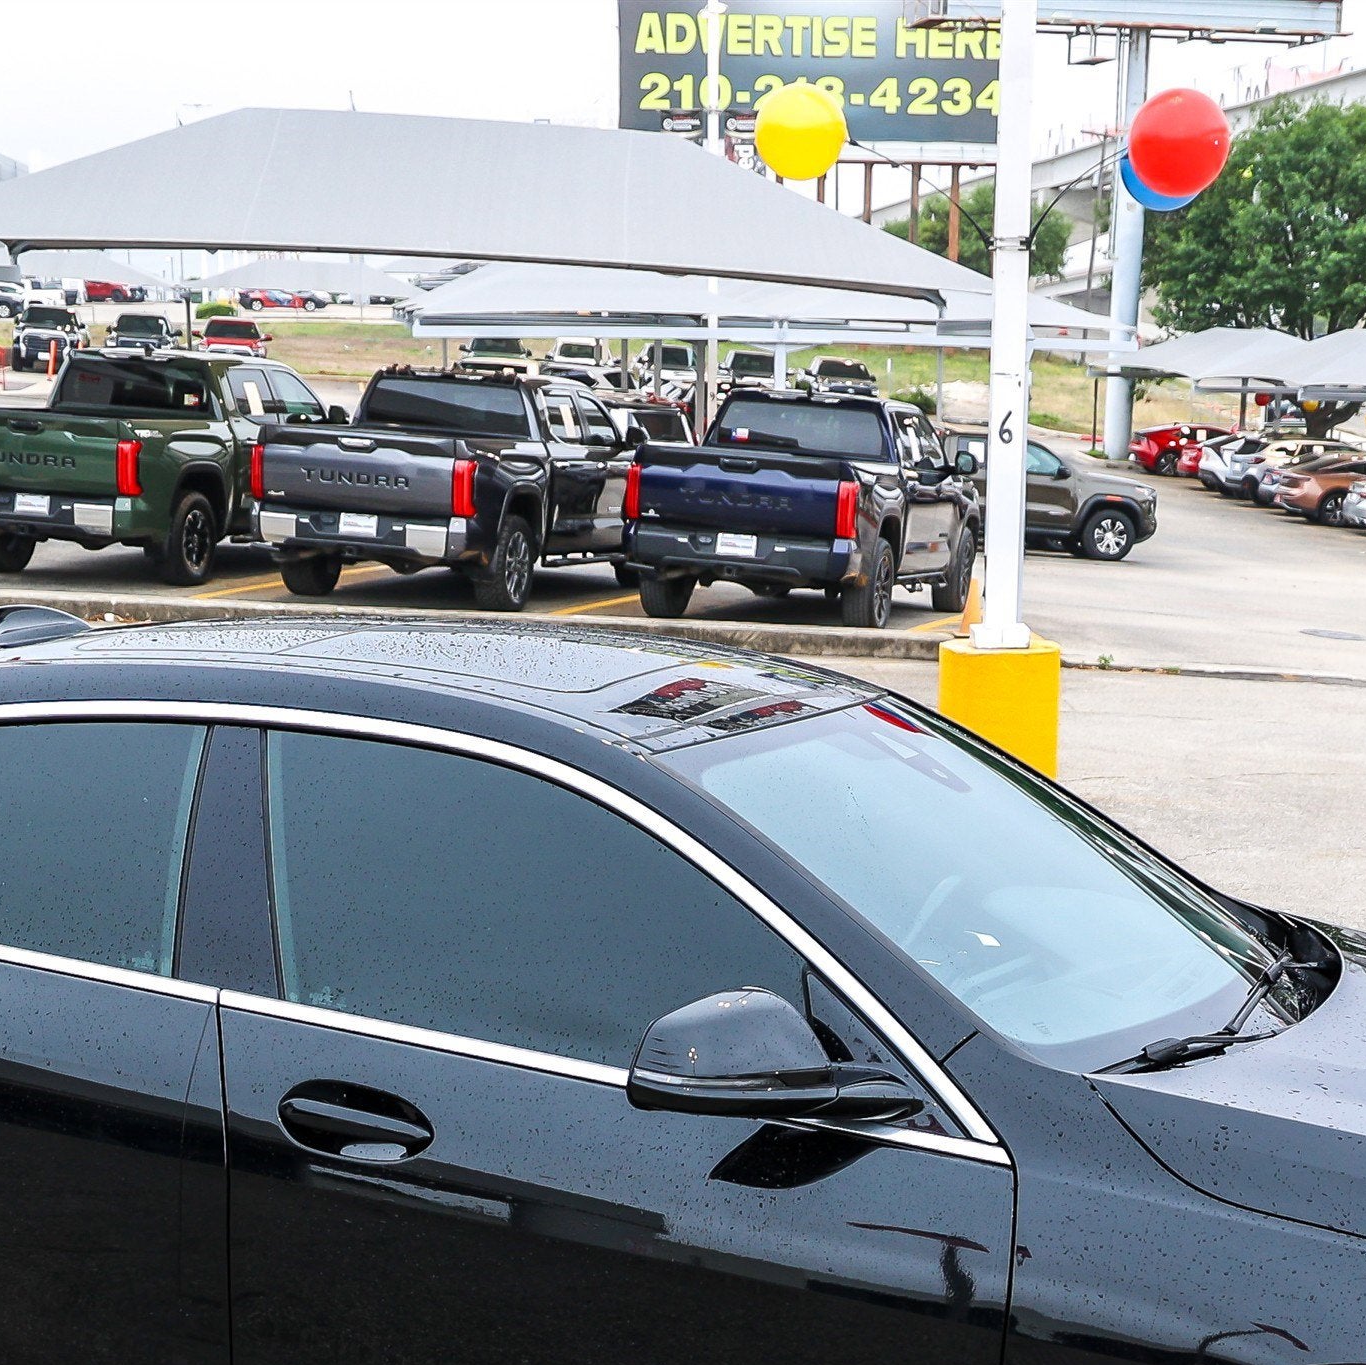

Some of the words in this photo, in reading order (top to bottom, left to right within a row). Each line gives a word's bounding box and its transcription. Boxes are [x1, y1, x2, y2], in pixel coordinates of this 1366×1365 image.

[634, 11, 877, 58] ADVERTISE
[895, 16, 1001, 60] HERE
[638, 72, 1000, 117] 210-28-4234
[998, 410, 1013, 444] 6
[301, 467, 410, 490] TUNDRA
